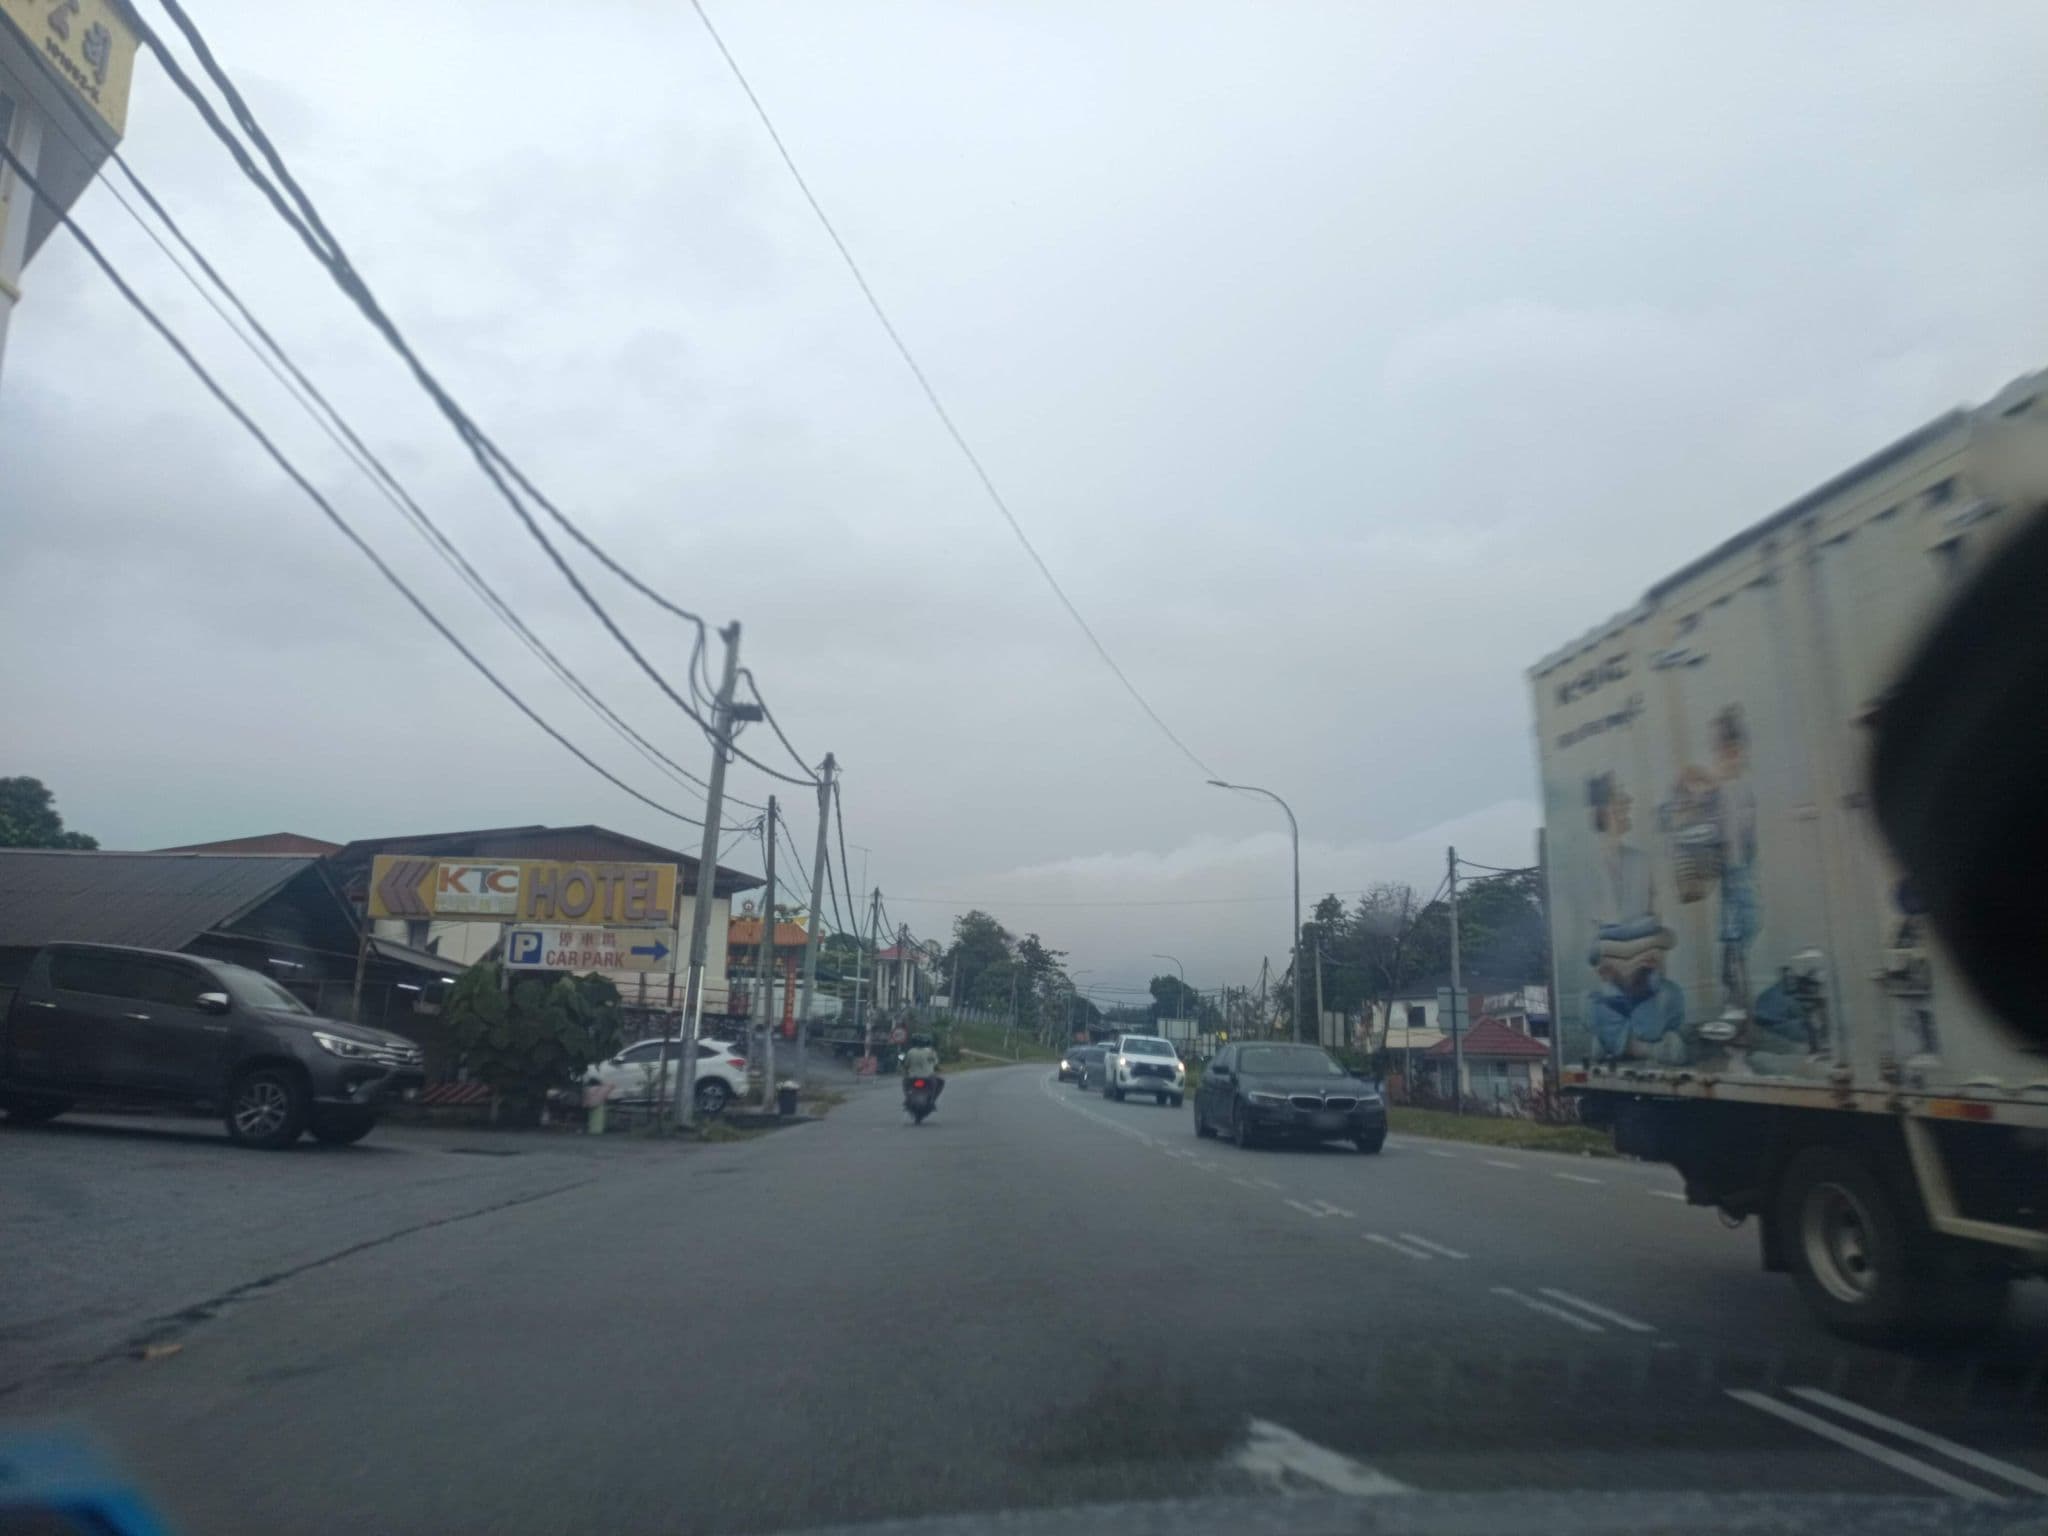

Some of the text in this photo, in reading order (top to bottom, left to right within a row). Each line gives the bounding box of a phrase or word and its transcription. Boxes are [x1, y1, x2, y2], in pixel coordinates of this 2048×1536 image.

[438, 866, 519, 893] KTC
[527, 867, 668, 920] HOTEL
[514, 936, 538, 962] P
[546, 950, 625, 968] CAR PARK
